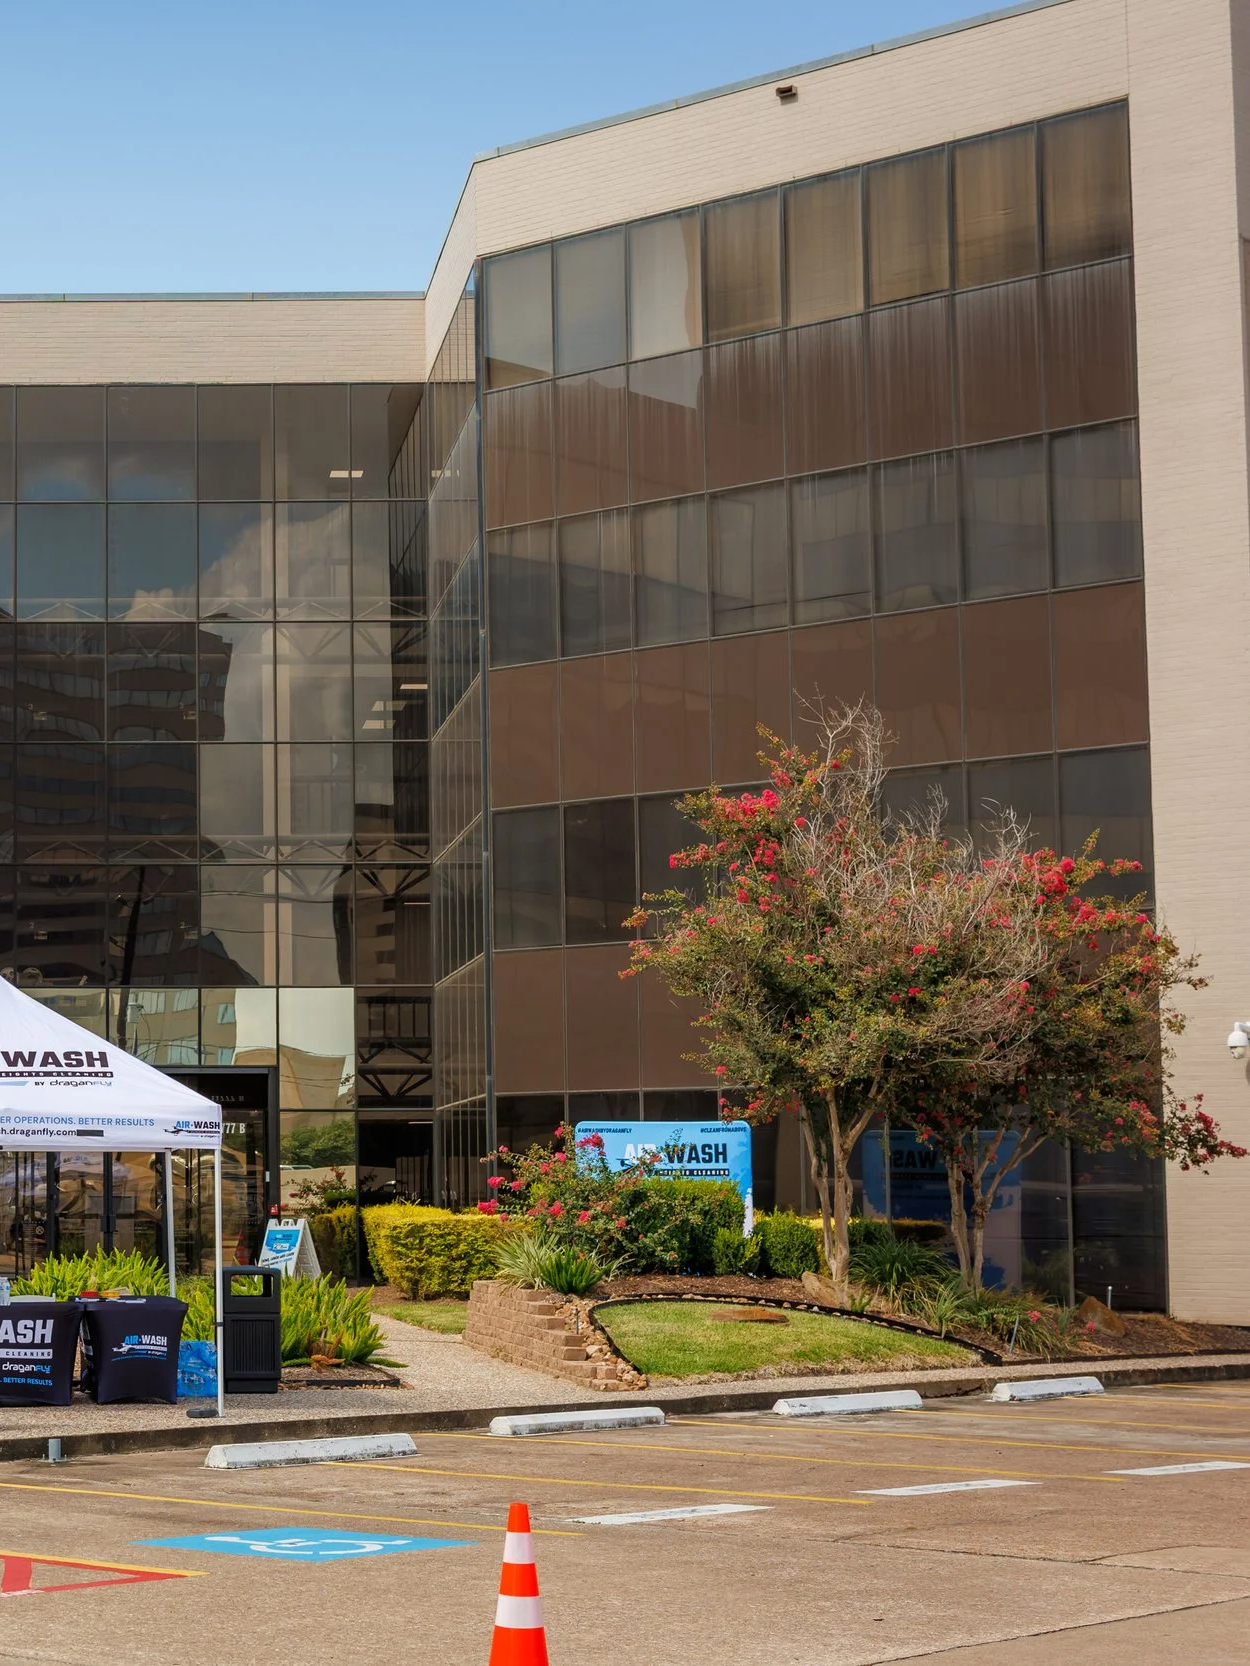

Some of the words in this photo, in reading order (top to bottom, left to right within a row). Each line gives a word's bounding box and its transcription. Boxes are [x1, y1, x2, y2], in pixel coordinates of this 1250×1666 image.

[14, 1116, 76, 1125] OPERATIONS.
[79, 1117, 112, 1126] BETTER
[115, 1118, 155, 1127] RESULTS
[27, 1378, 53, 1386] RESULTS
